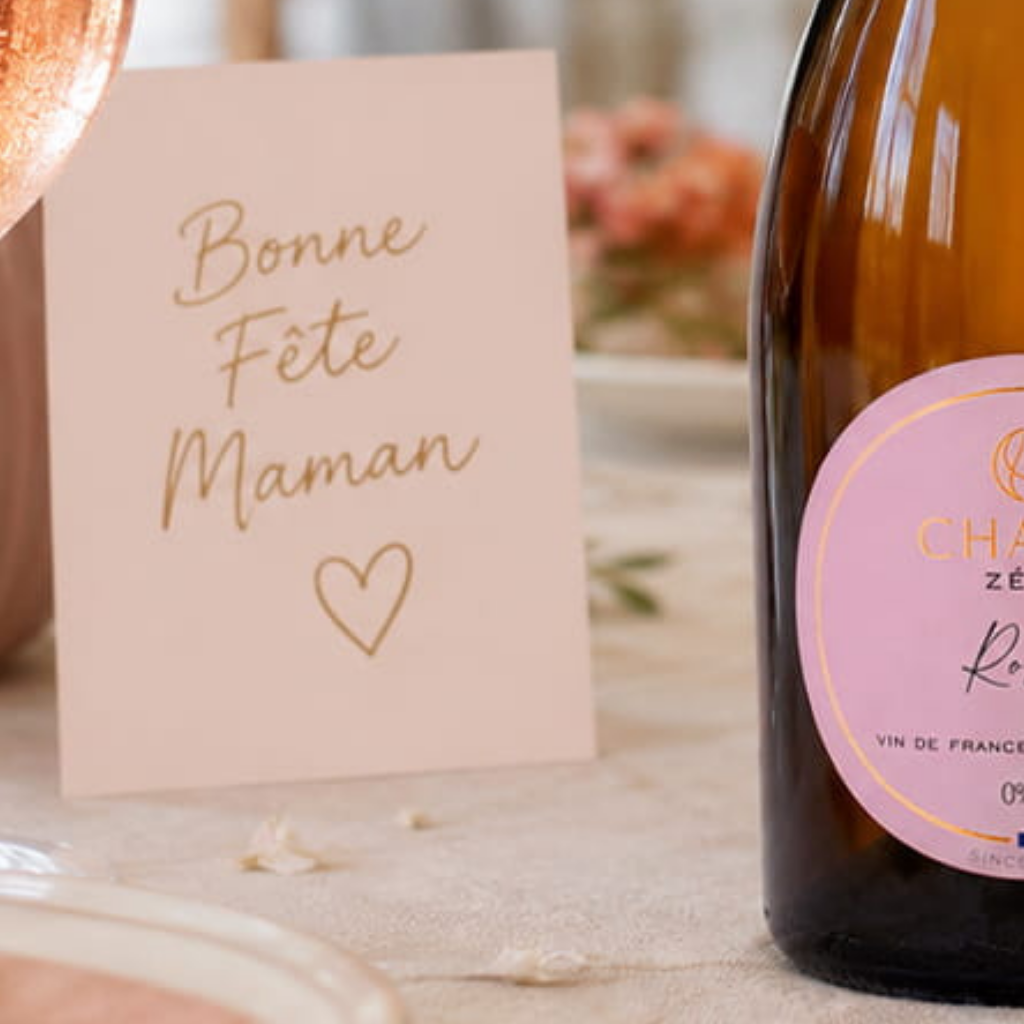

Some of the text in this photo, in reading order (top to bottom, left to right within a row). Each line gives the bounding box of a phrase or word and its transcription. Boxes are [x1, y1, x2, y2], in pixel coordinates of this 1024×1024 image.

[173, 198, 428, 307] Bonne
[215, 298, 400, 409] Fête
[161, 428, 481, 532] Maman
[875, 734, 905, 749] VIN
[914, 736, 940, 751] DE
